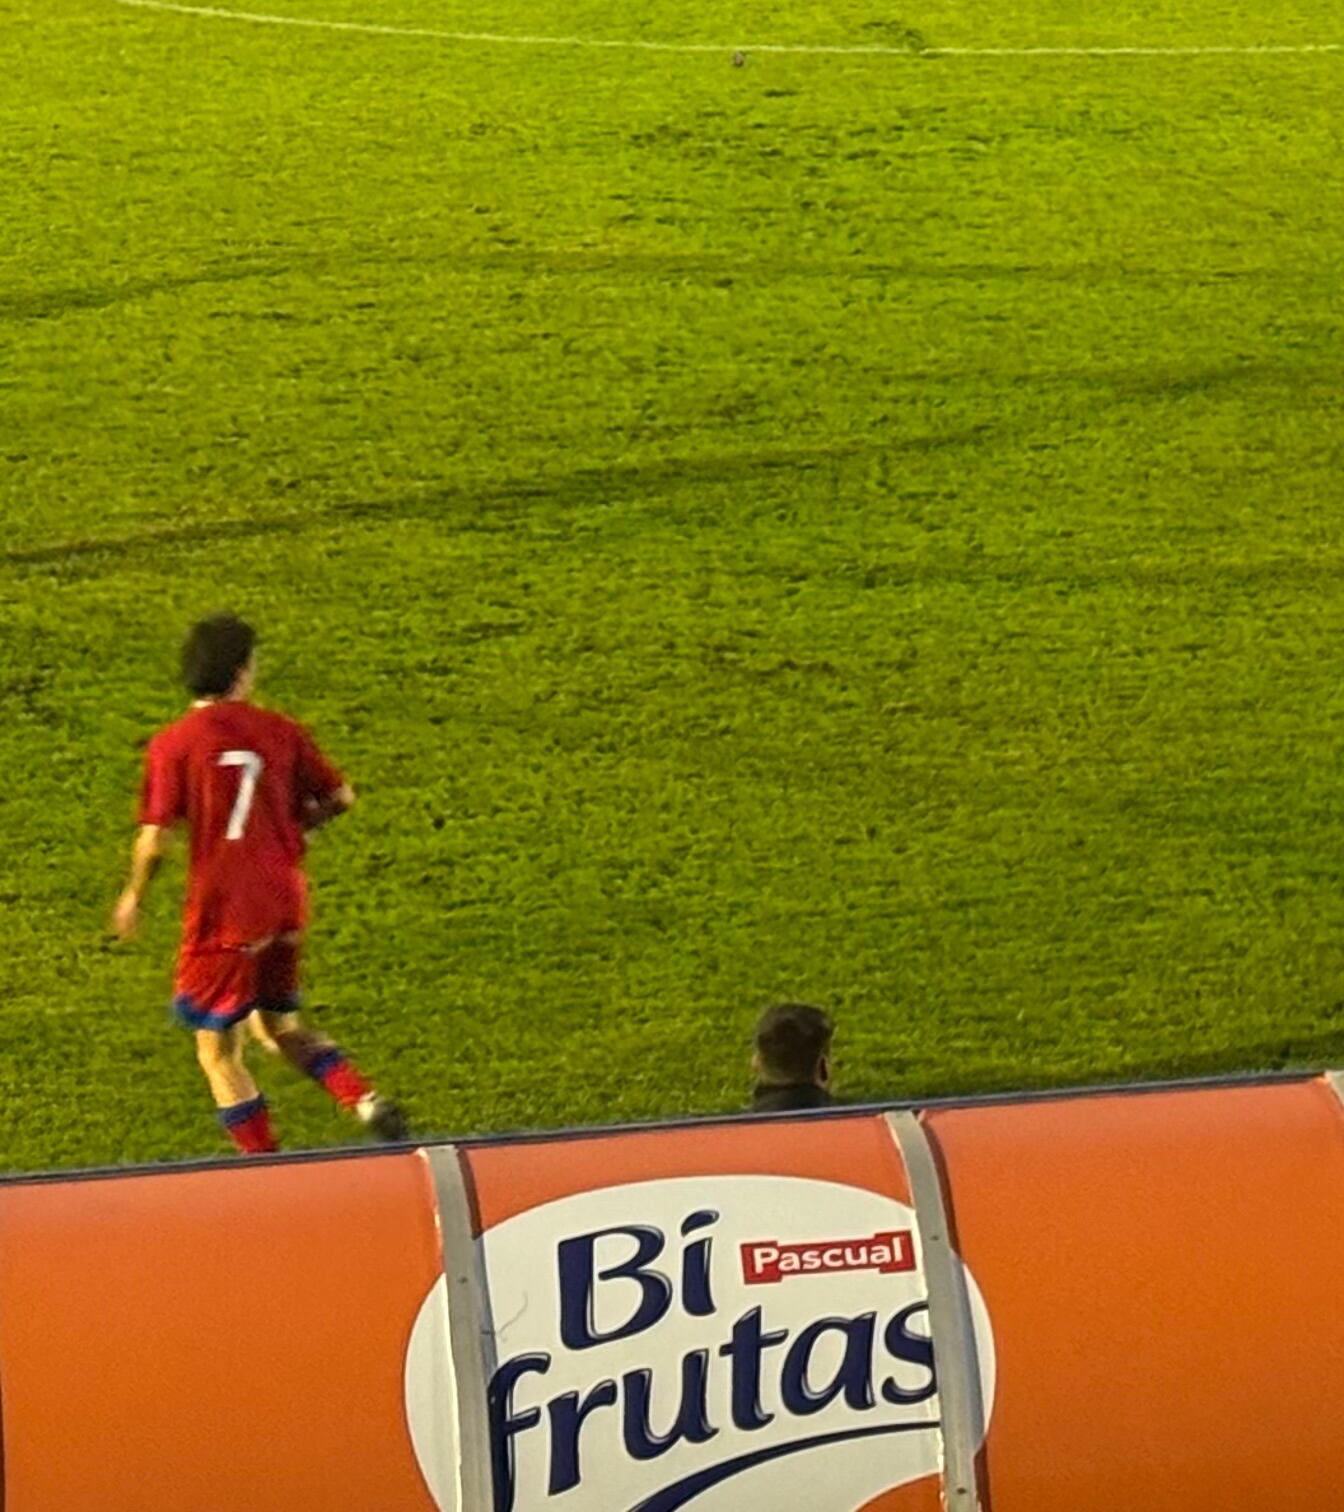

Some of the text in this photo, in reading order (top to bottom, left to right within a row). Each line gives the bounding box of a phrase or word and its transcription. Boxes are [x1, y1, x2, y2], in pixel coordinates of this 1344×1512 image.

[218, 750, 261, 840] 7
[557, 1209, 720, 1351] Bi
[753, 1234, 903, 1273] Pascual
[487, 1301, 941, 1512] frutas
